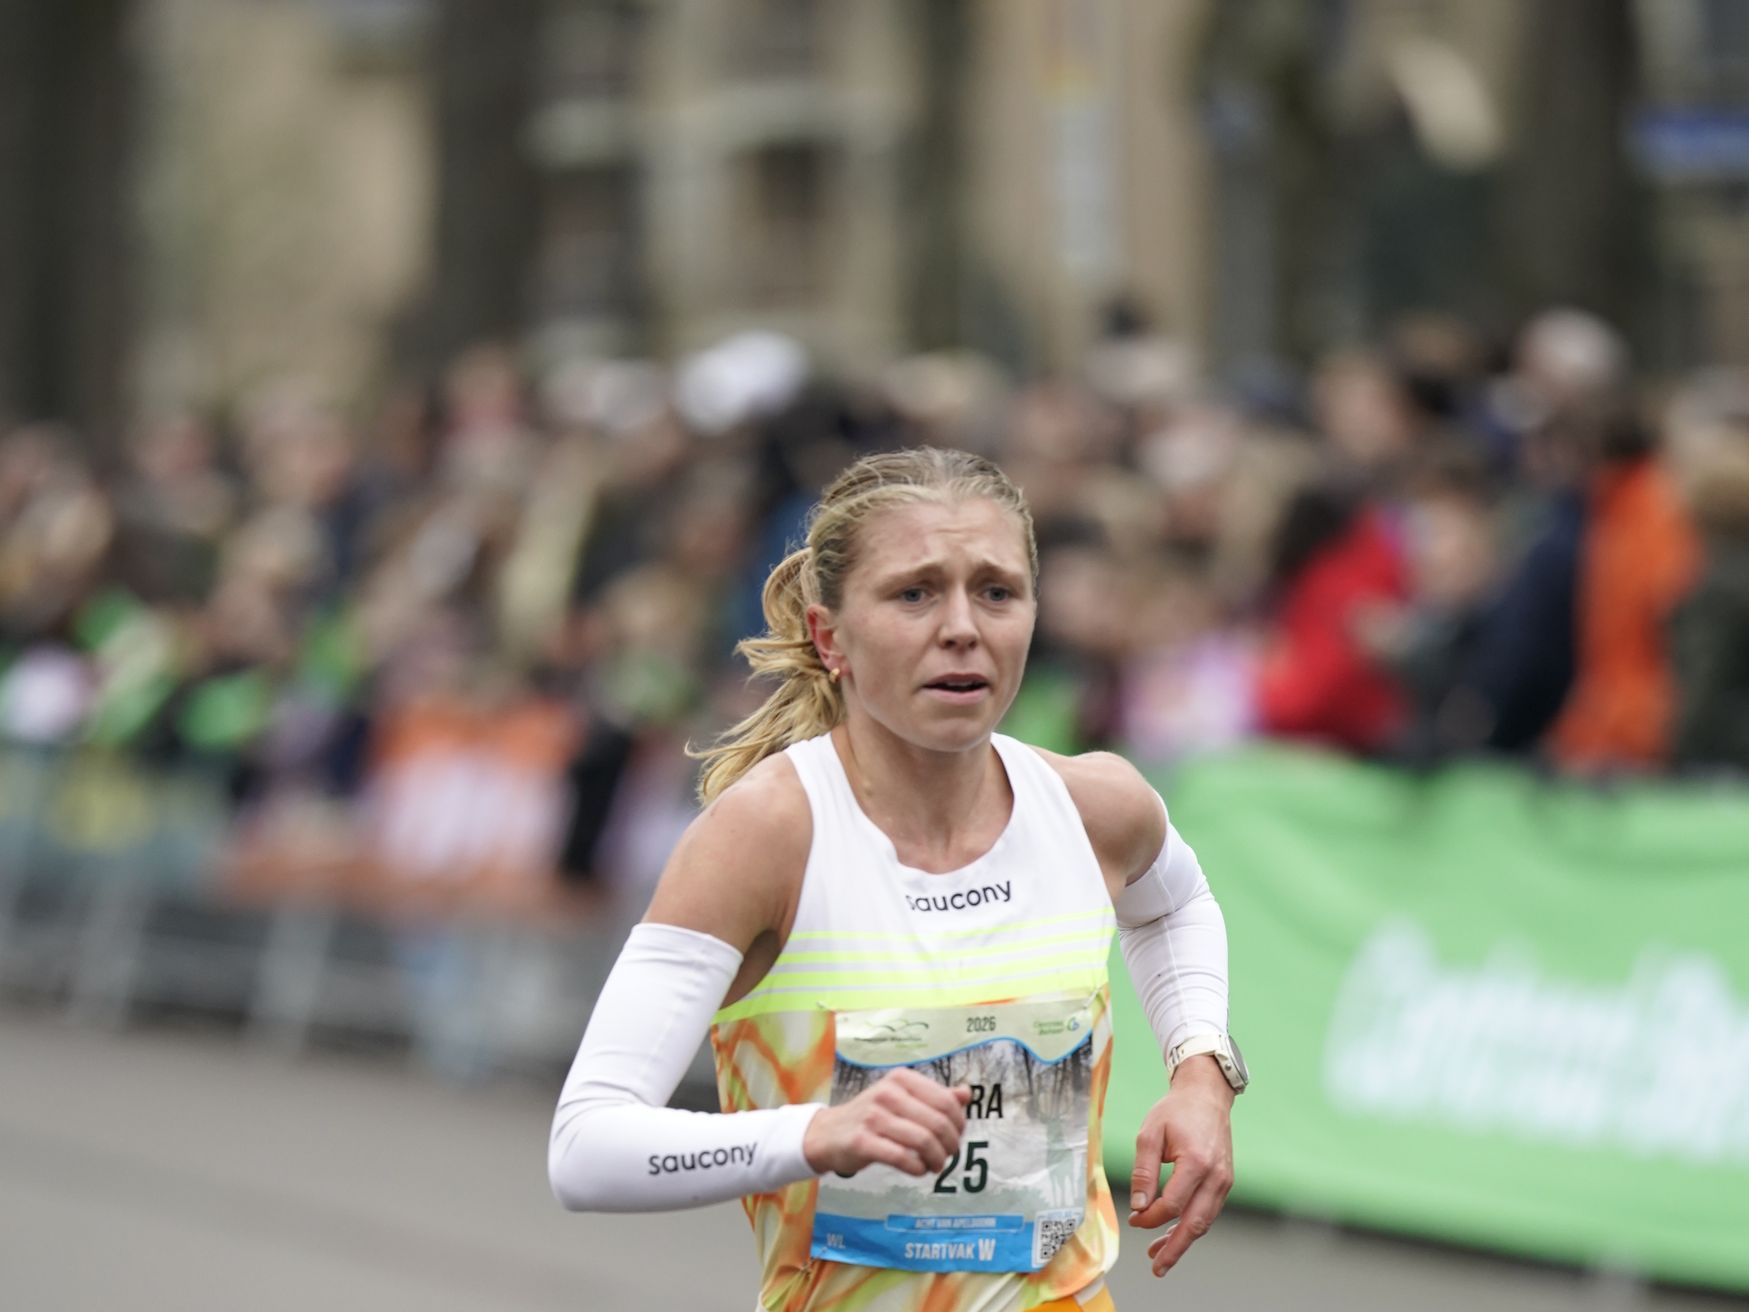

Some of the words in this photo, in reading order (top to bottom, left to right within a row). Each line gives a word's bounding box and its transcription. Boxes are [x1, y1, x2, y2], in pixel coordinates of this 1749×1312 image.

[648, 1141, 757, 1175] saucony
[934, 1141, 988, 1193] 25
[904, 1242, 975, 1260] STARTVAK
[978, 1238, 996, 1261] W
